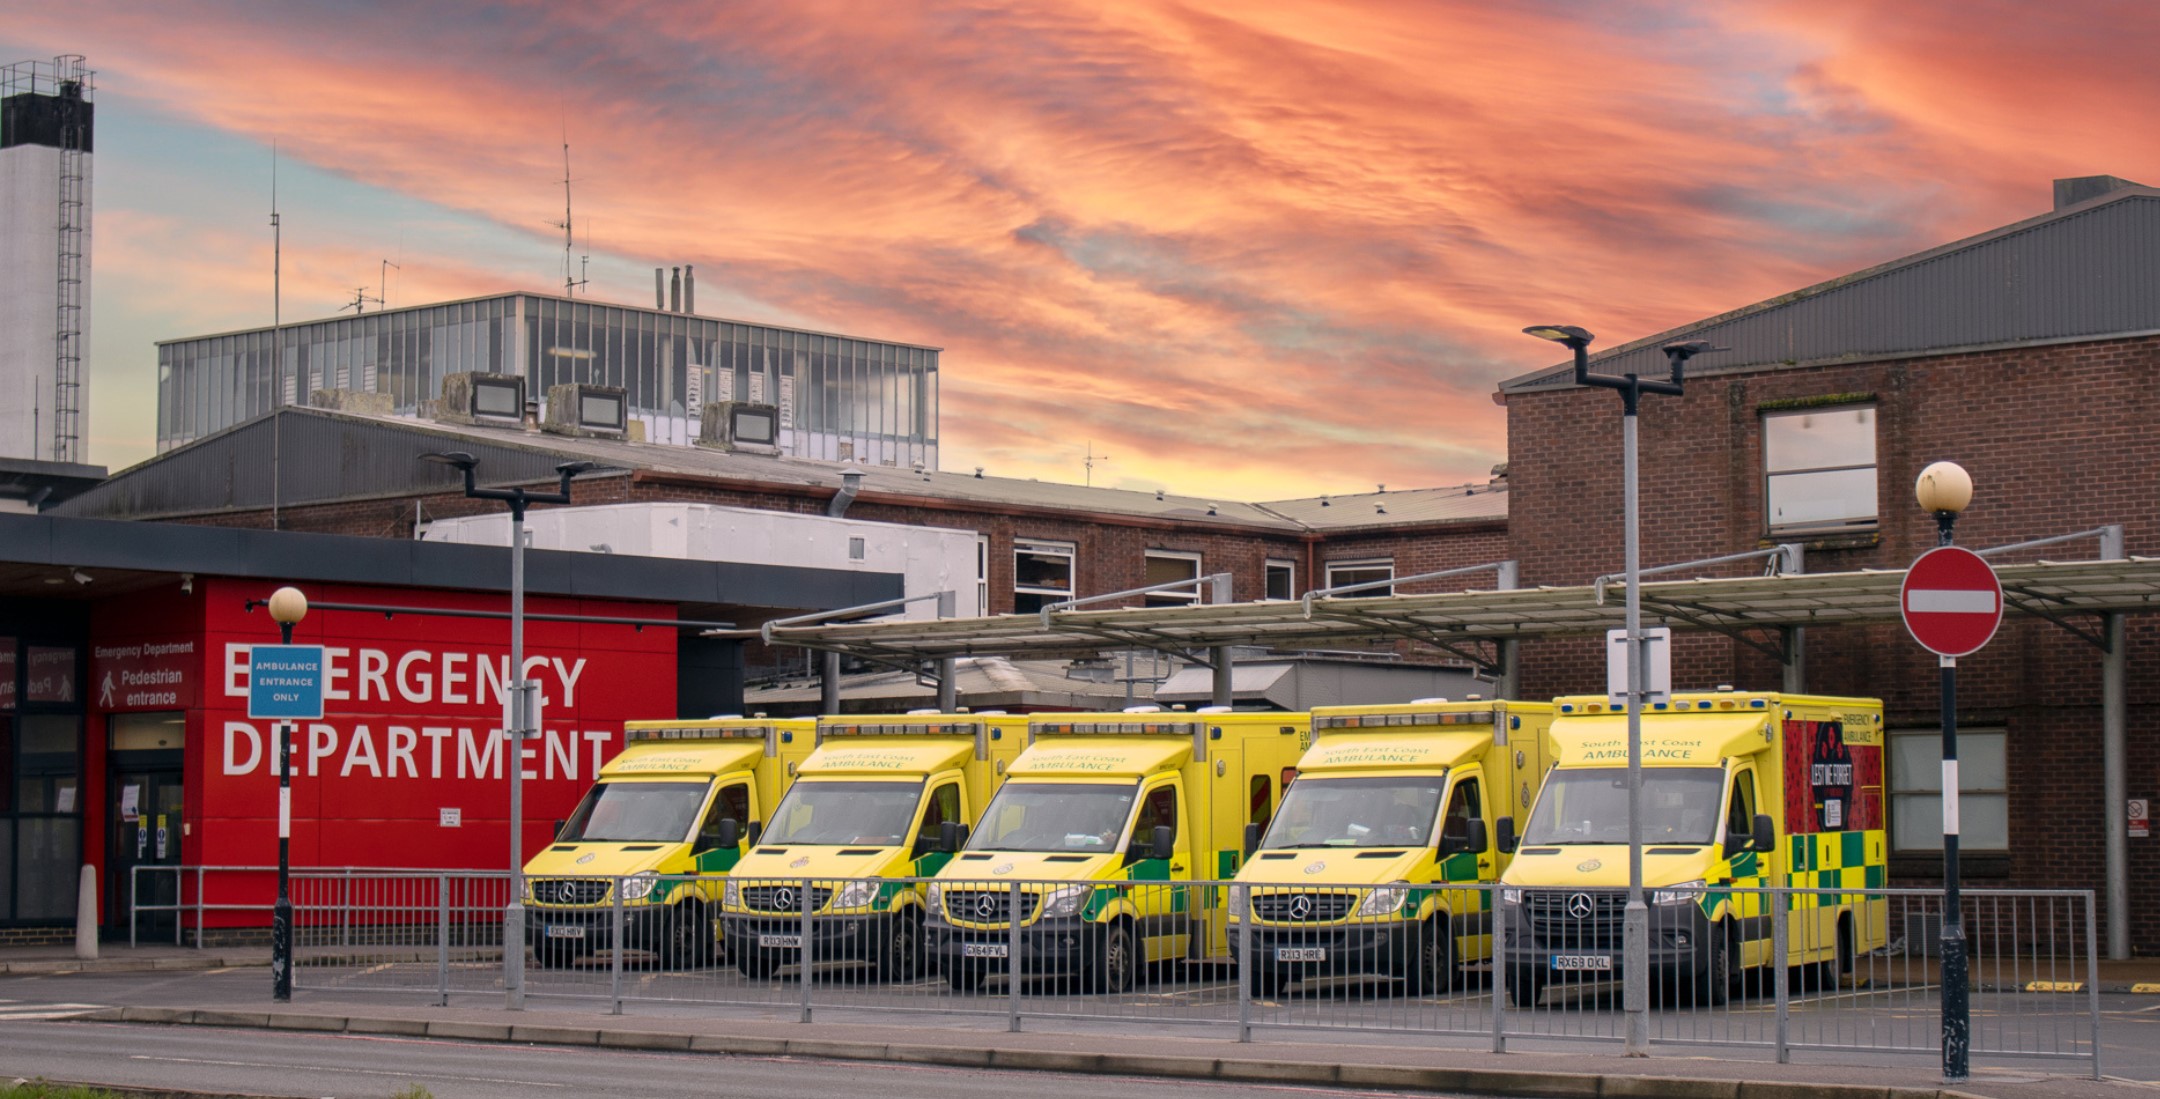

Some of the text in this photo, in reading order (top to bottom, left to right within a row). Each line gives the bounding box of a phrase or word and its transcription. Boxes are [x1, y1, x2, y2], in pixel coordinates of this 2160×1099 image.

[95, 641, 194, 660] Emergency Department
[256, 662, 318, 671] AMBULANCE
[121, 669, 182, 685] Pedestrian
[225, 643, 587, 708] EERGENCY
[259, 677, 313, 687] ENTRANCE
[127, 691, 177, 706] entrance
[273, 693, 299, 702] ONLY
[1580, 740, 1621, 748] South
[1661, 739, 1702, 747] Coast
[1324, 747, 1359, 755] South
[1393, 746, 1430, 754] Coast
[1583, 749, 1693, 760] AMBUANCE
[1093, 755, 1127, 763] Coast
[1323, 753, 1420, 764] AMBULANCE
[618, 763, 690, 771] AMBULANCE
[821, 760, 904, 769] AMBULANCE
[1029, 761, 1114, 771] AMBULANCE
[1811, 764, 1825, 786] LEST
[1833, 764, 1853, 786] FORGET
[988, 946, 1006, 956] FVL
